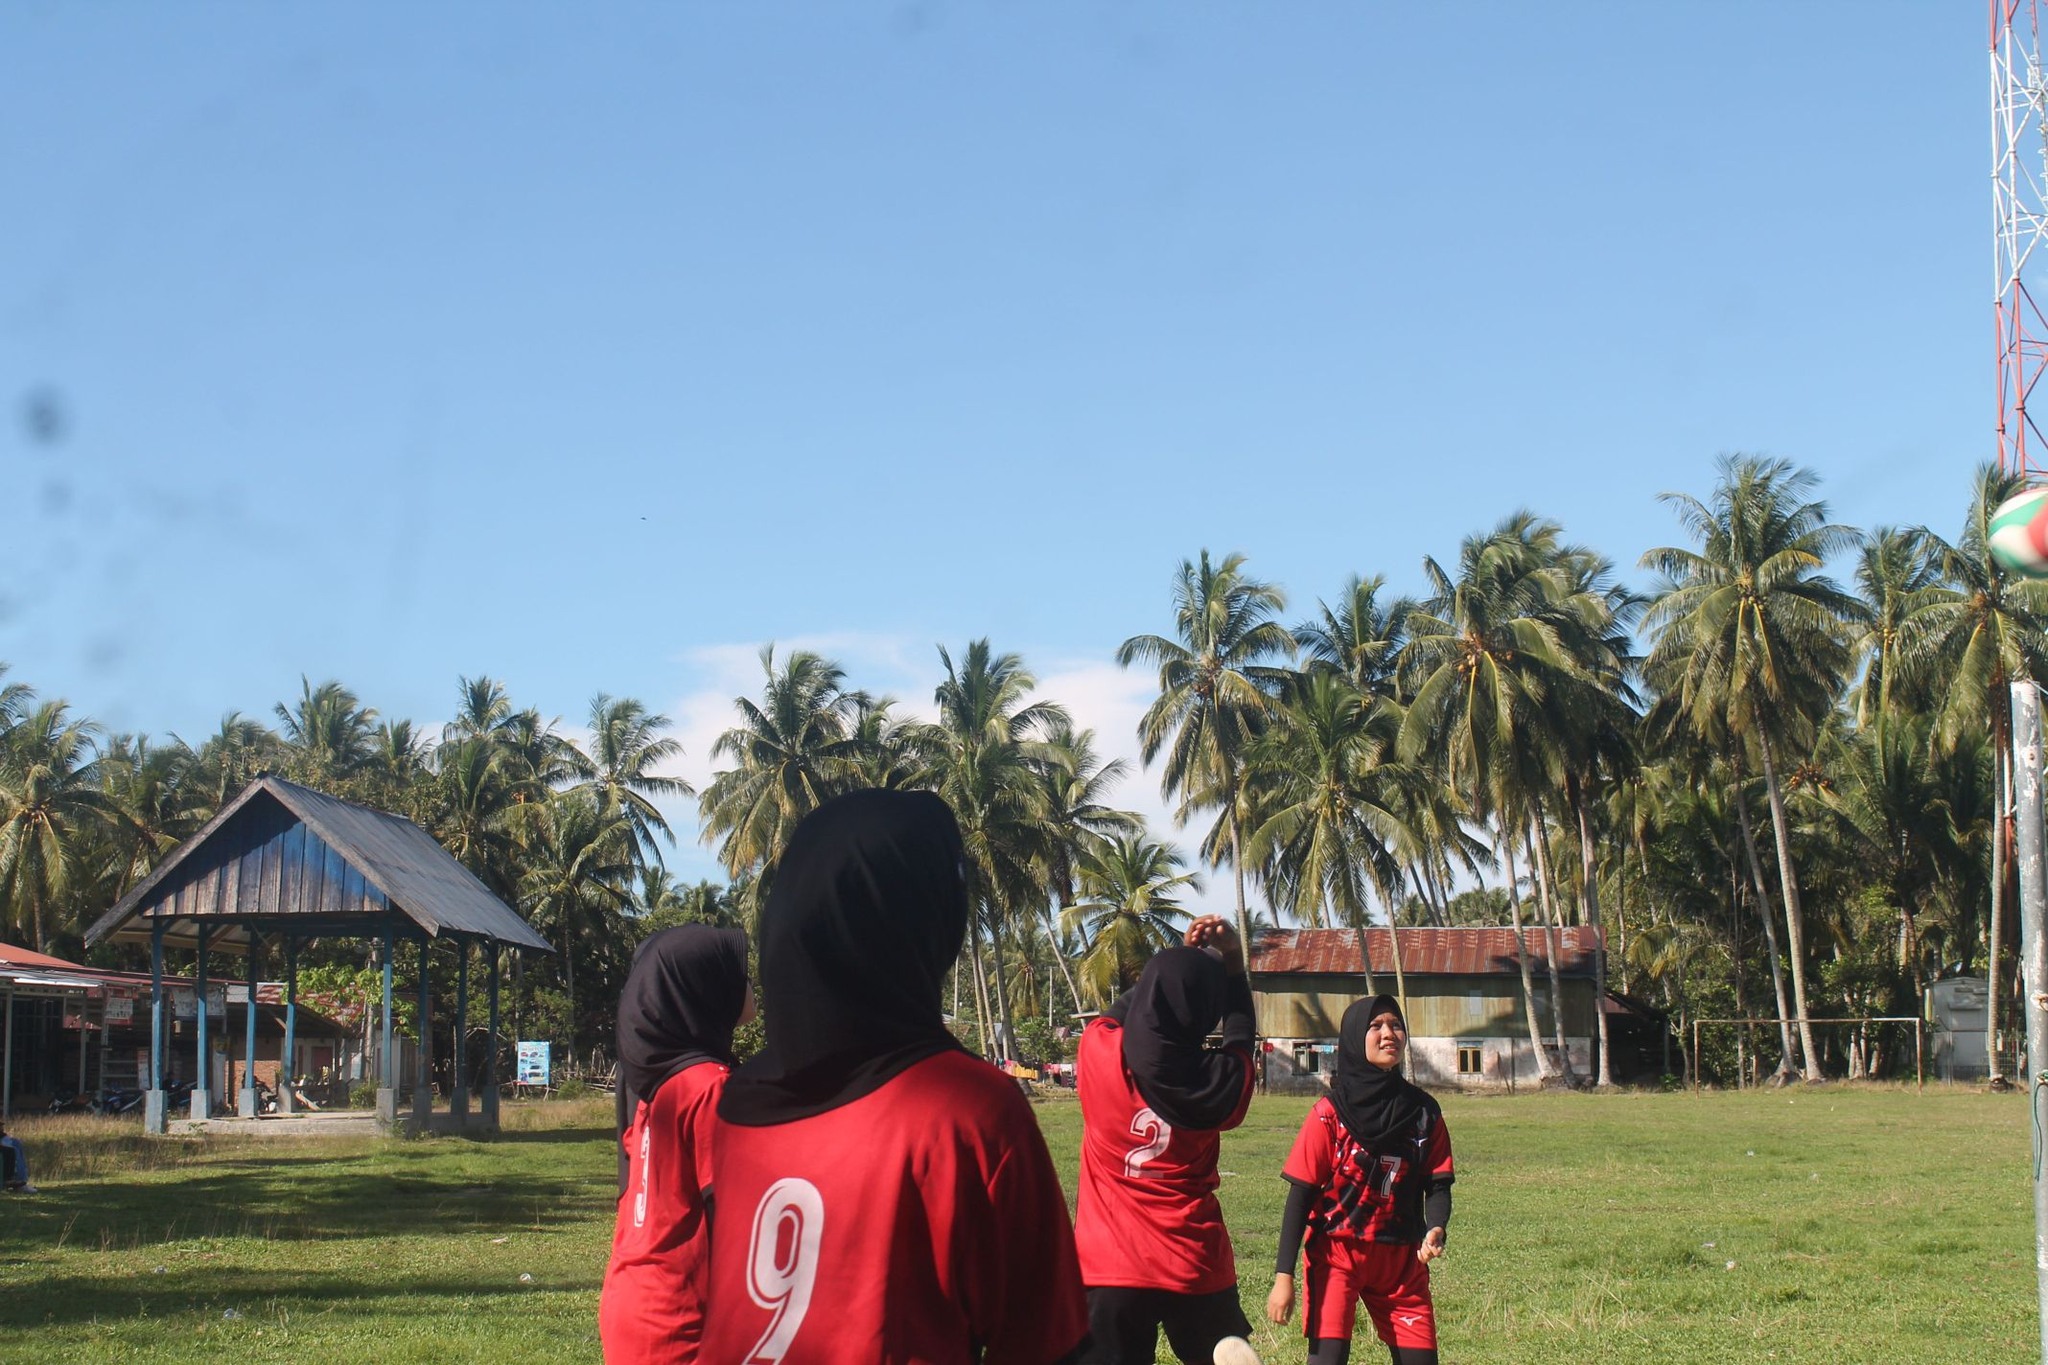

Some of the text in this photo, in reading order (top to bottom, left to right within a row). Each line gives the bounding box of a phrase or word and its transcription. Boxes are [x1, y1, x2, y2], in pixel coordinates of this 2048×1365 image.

[1124, 1107, 1171, 1178] 2
[1380, 1155, 1402, 1198] 7
[741, 1177, 825, 1365] 9
